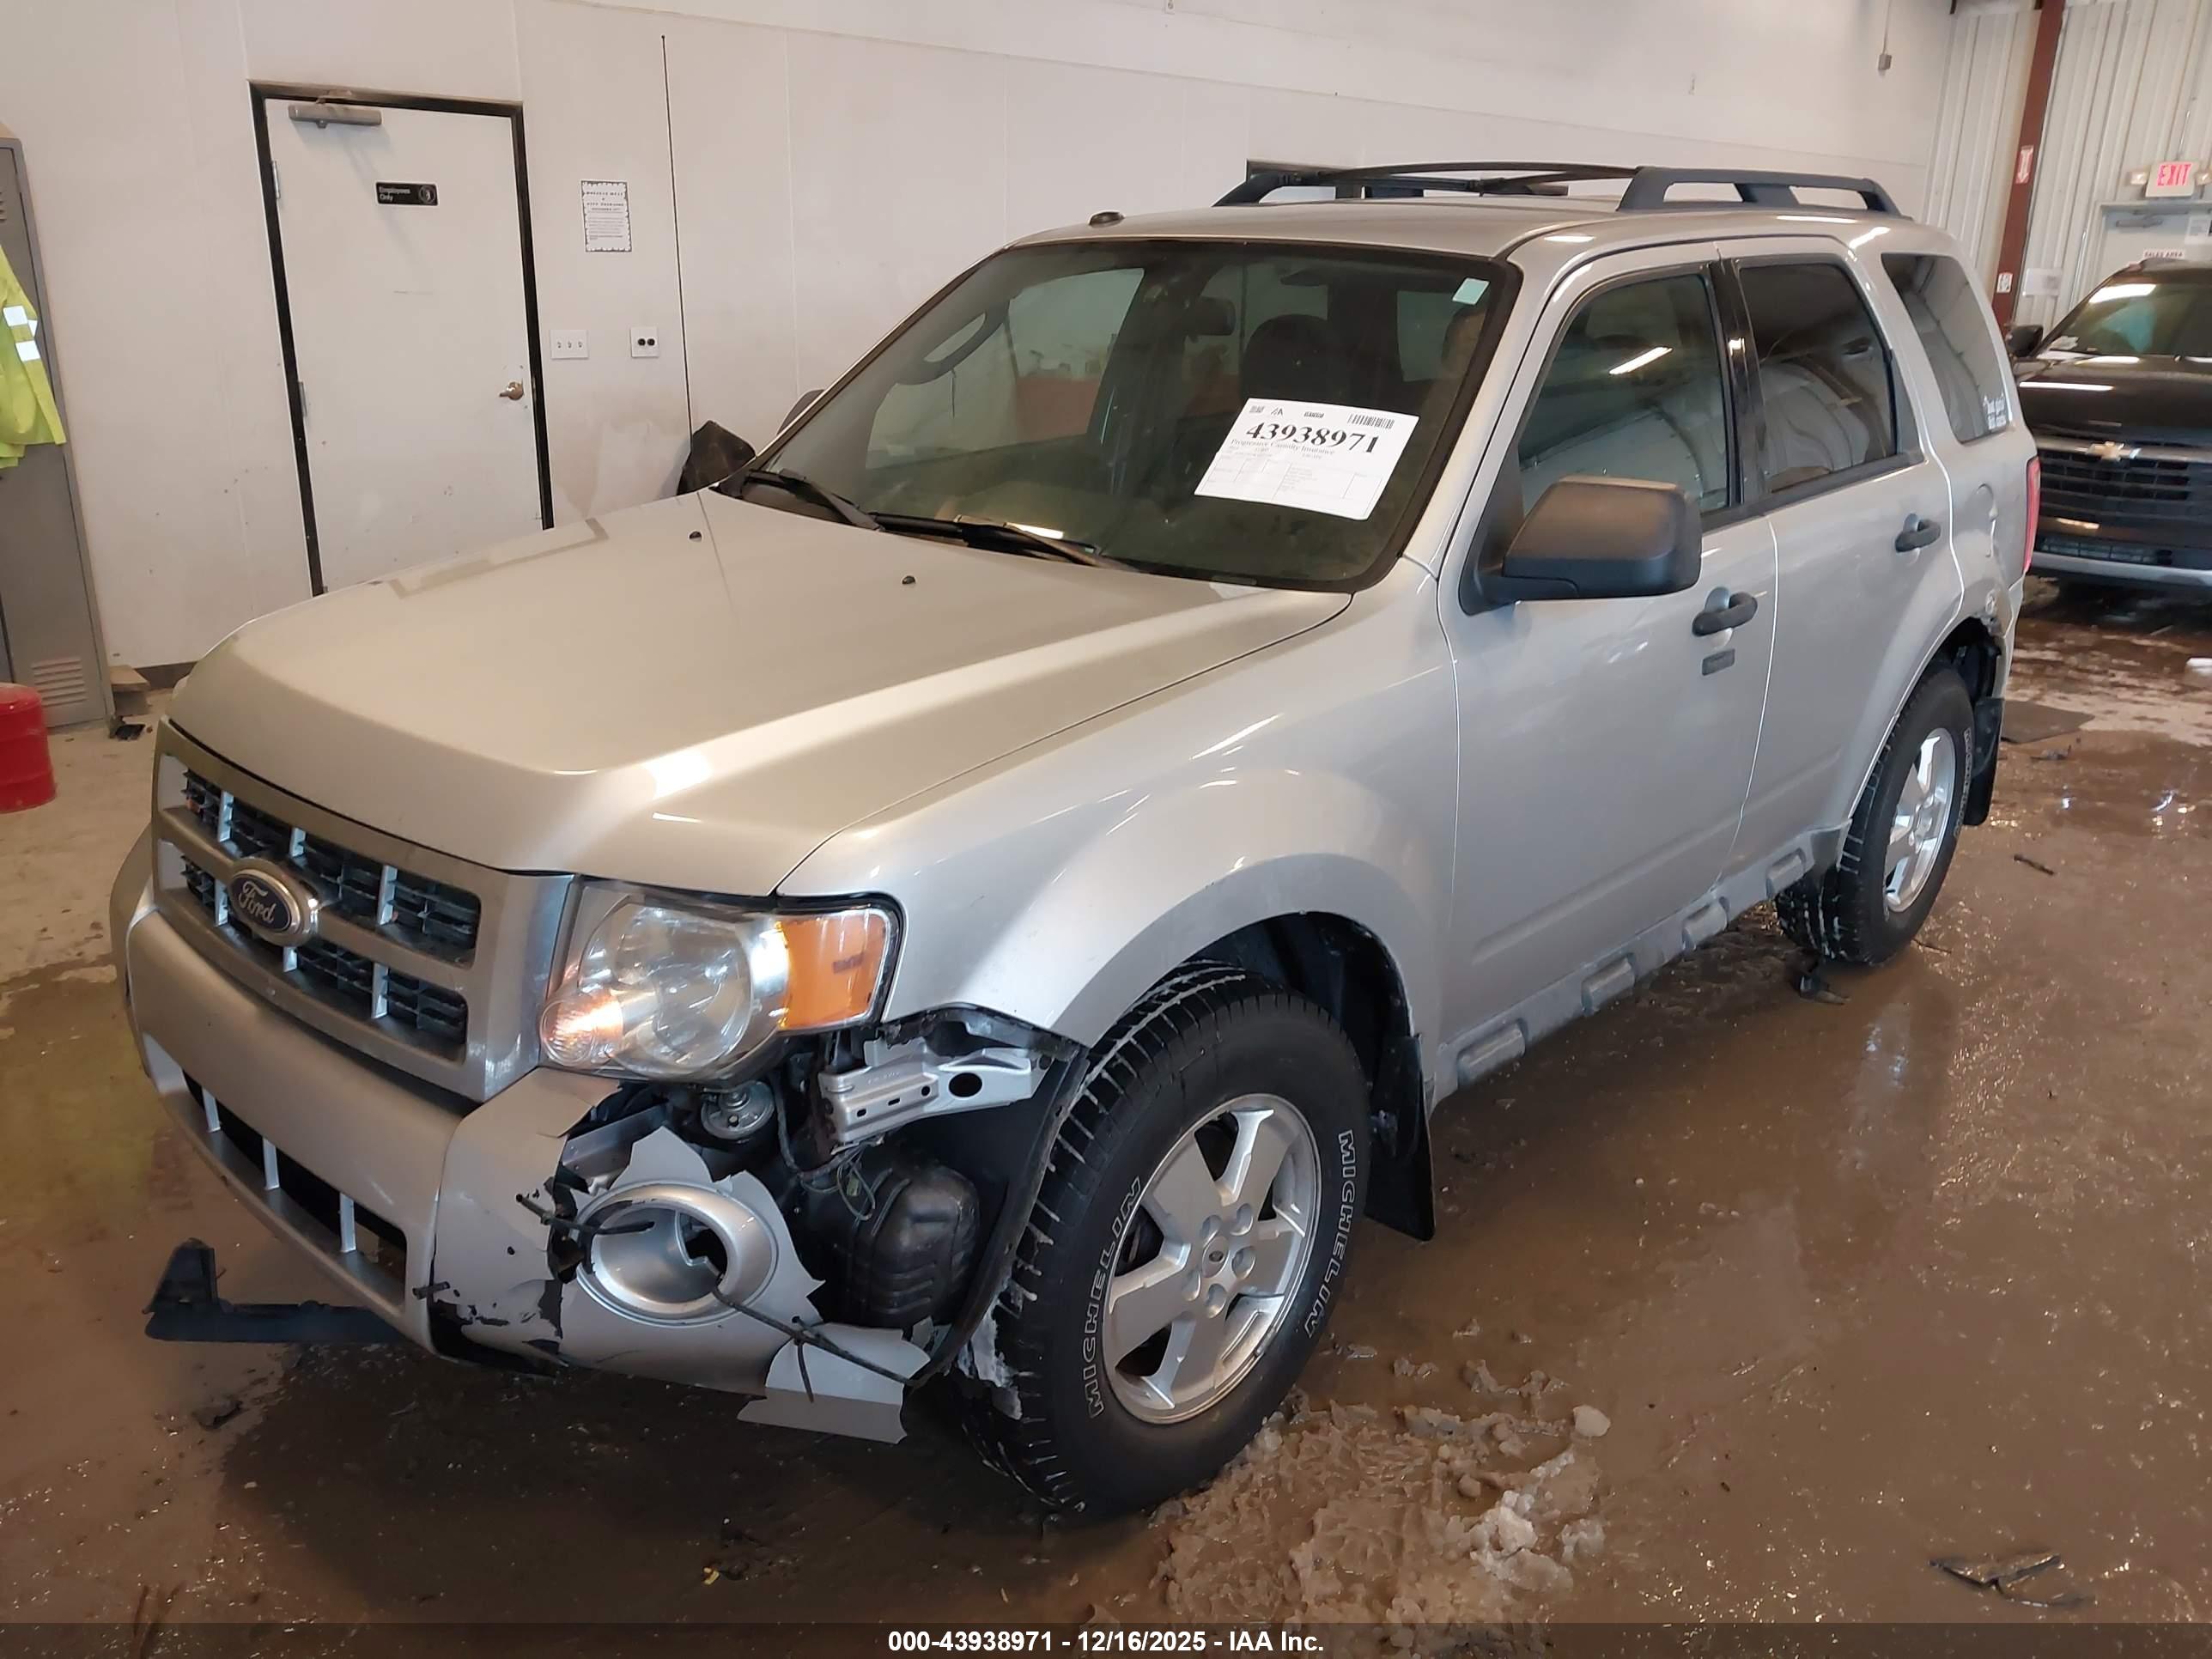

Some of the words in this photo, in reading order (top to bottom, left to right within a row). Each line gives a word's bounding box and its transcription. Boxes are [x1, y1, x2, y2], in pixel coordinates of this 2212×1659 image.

[2157, 163, 2192, 186] EXIT
[1246, 422, 1379, 453] 43938971
[238, 881, 277, 923] Ford
[1304, 1128, 1357, 1339] MICHELIN
[1082, 1176, 1141, 1419] MICHELIN
